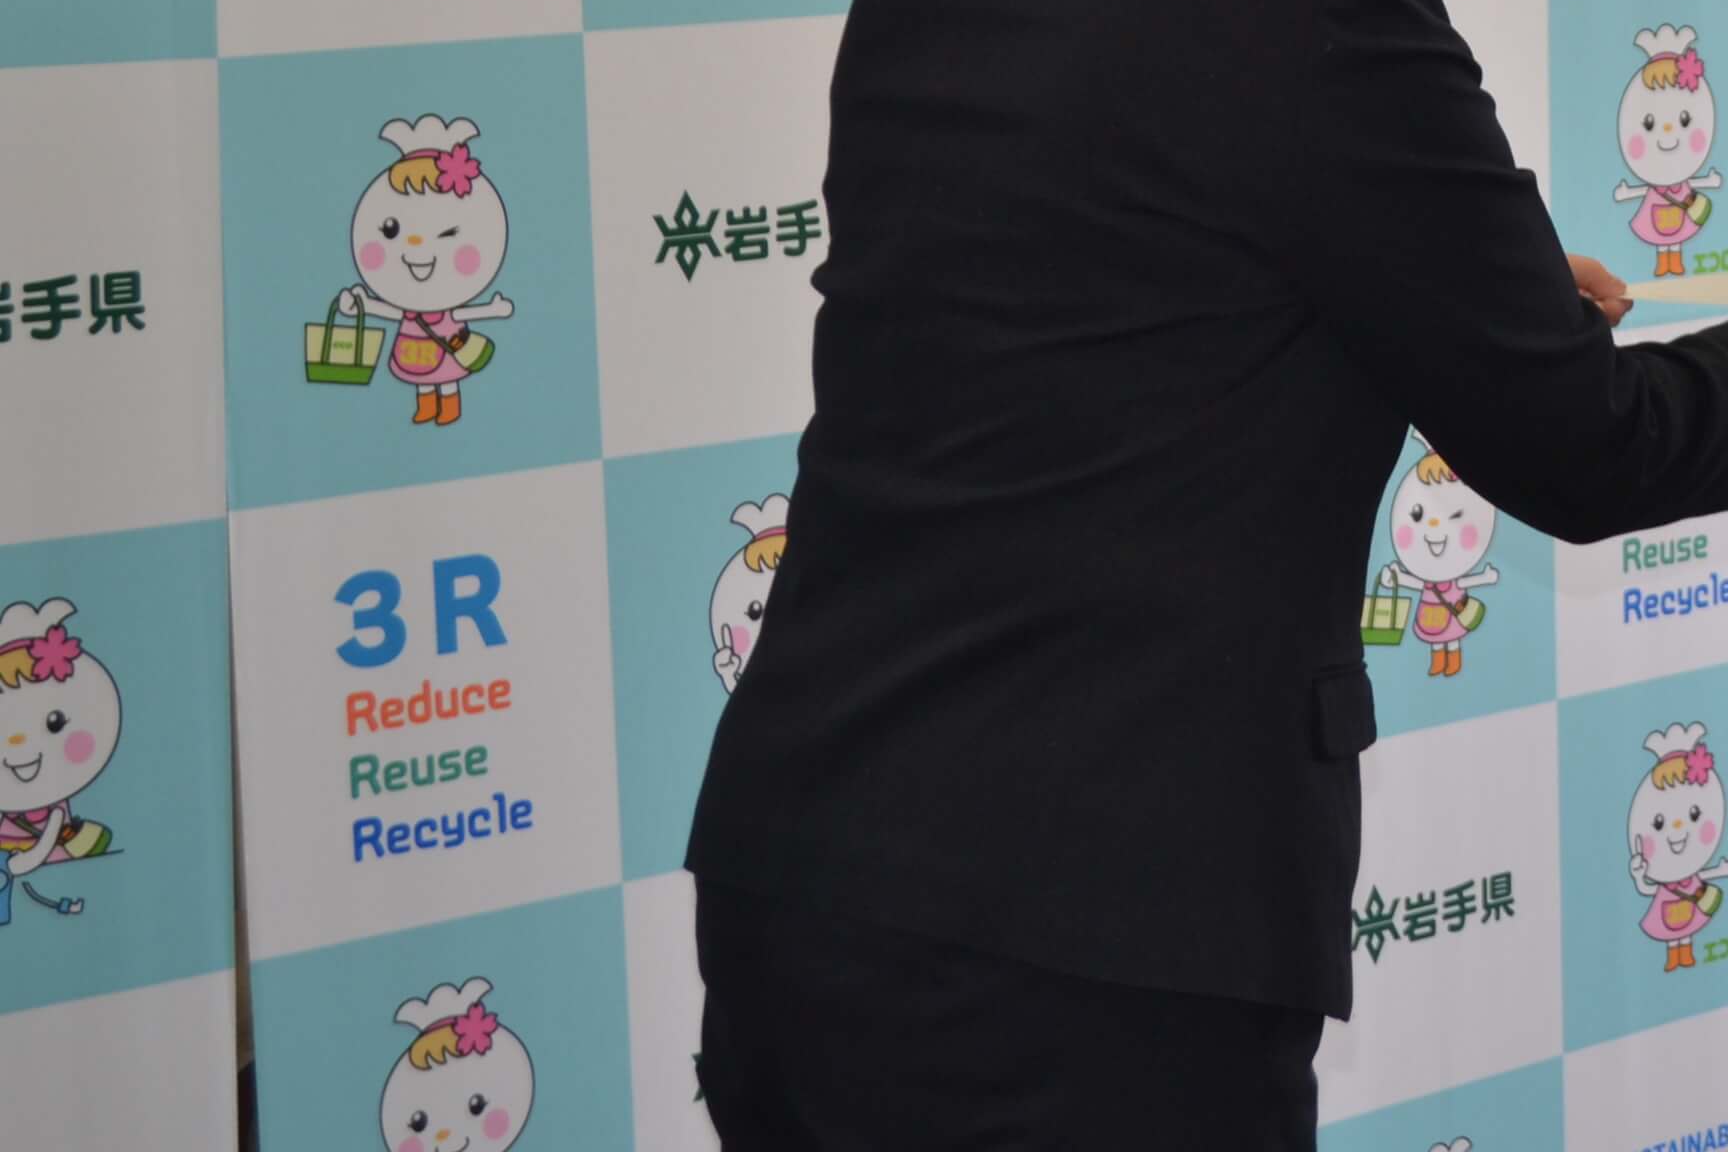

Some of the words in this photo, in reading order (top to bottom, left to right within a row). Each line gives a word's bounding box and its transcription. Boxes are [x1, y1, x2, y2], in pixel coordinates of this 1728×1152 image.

[0, 270, 146, 344] 手県
[1622, 534, 1708, 574] Reuse
[334, 554, 509, 669] 3R
[346, 678, 513, 737] Reduce
[350, 745, 489, 800] Reuse
[352, 791, 534, 864] Recycle
[1404, 873, 1515, 943] 岩手県
